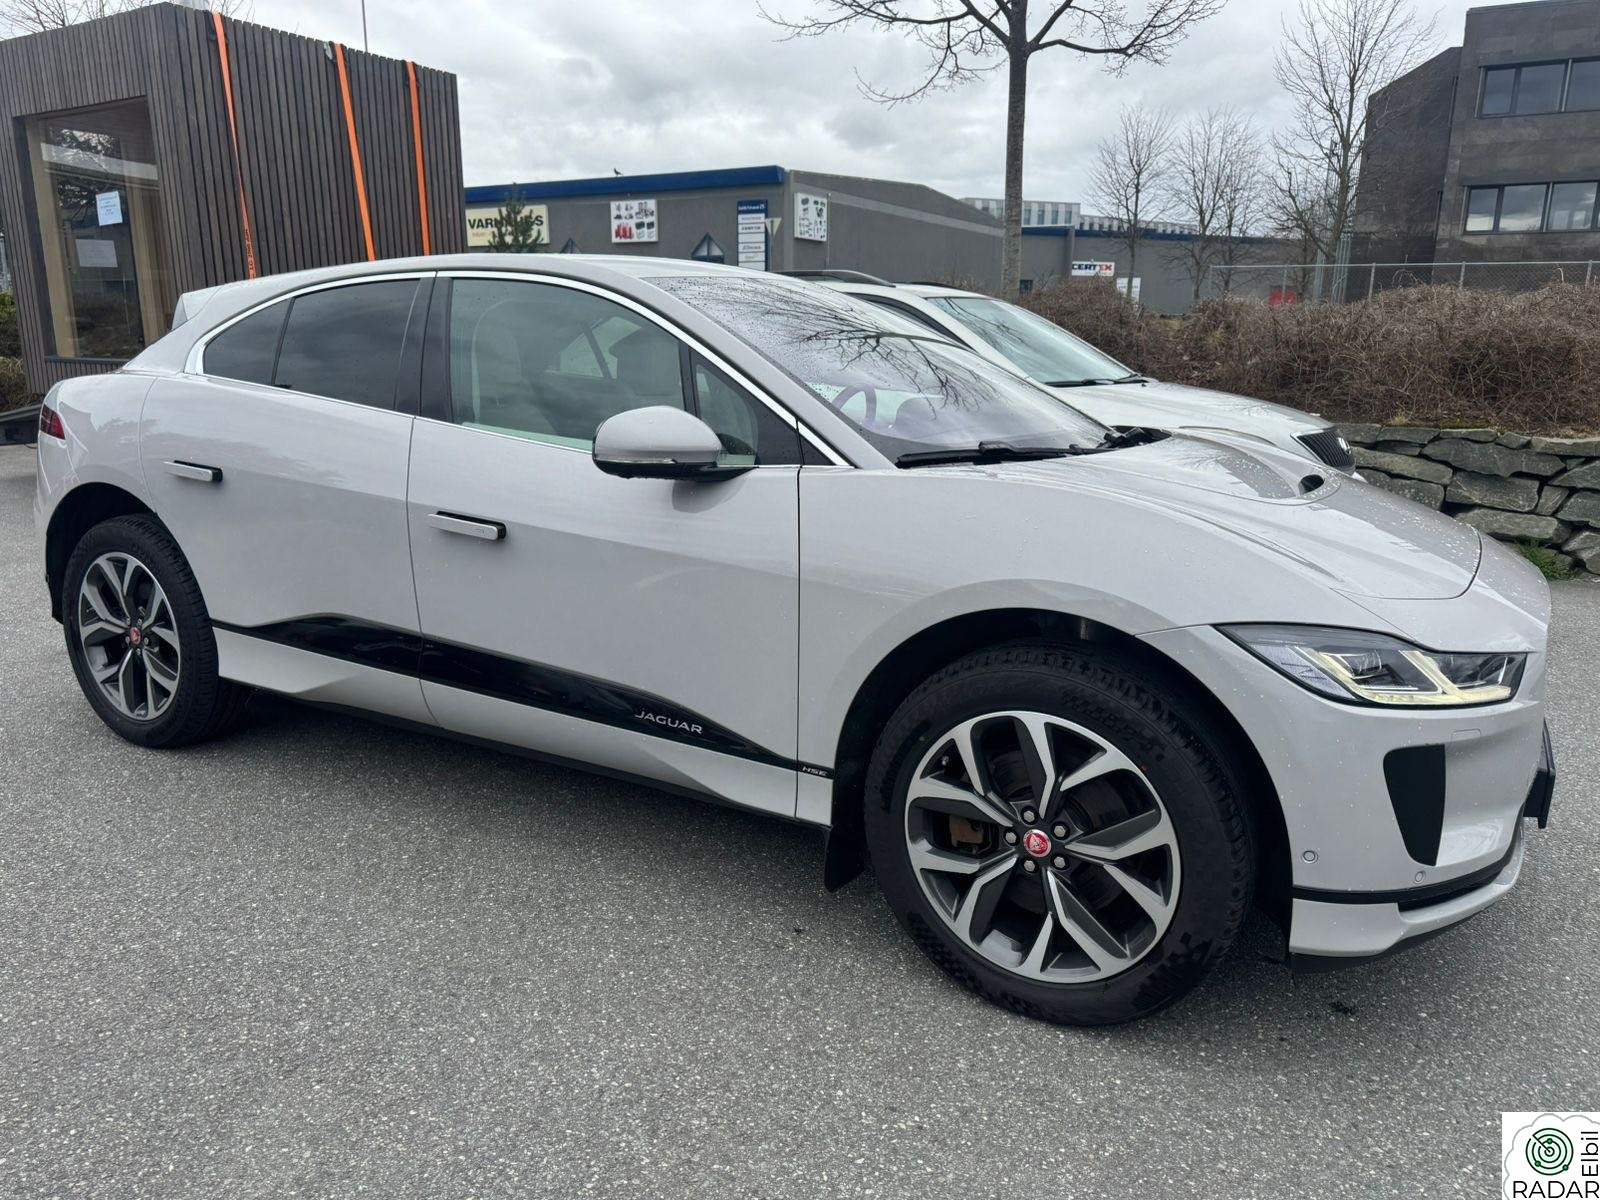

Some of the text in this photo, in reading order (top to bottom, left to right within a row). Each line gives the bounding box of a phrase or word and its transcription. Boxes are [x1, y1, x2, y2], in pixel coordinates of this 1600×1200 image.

[1072, 263, 1113, 271] CERTEX
[634, 711, 703, 734] JAGUAR
[802, 766, 828, 777] HSE
